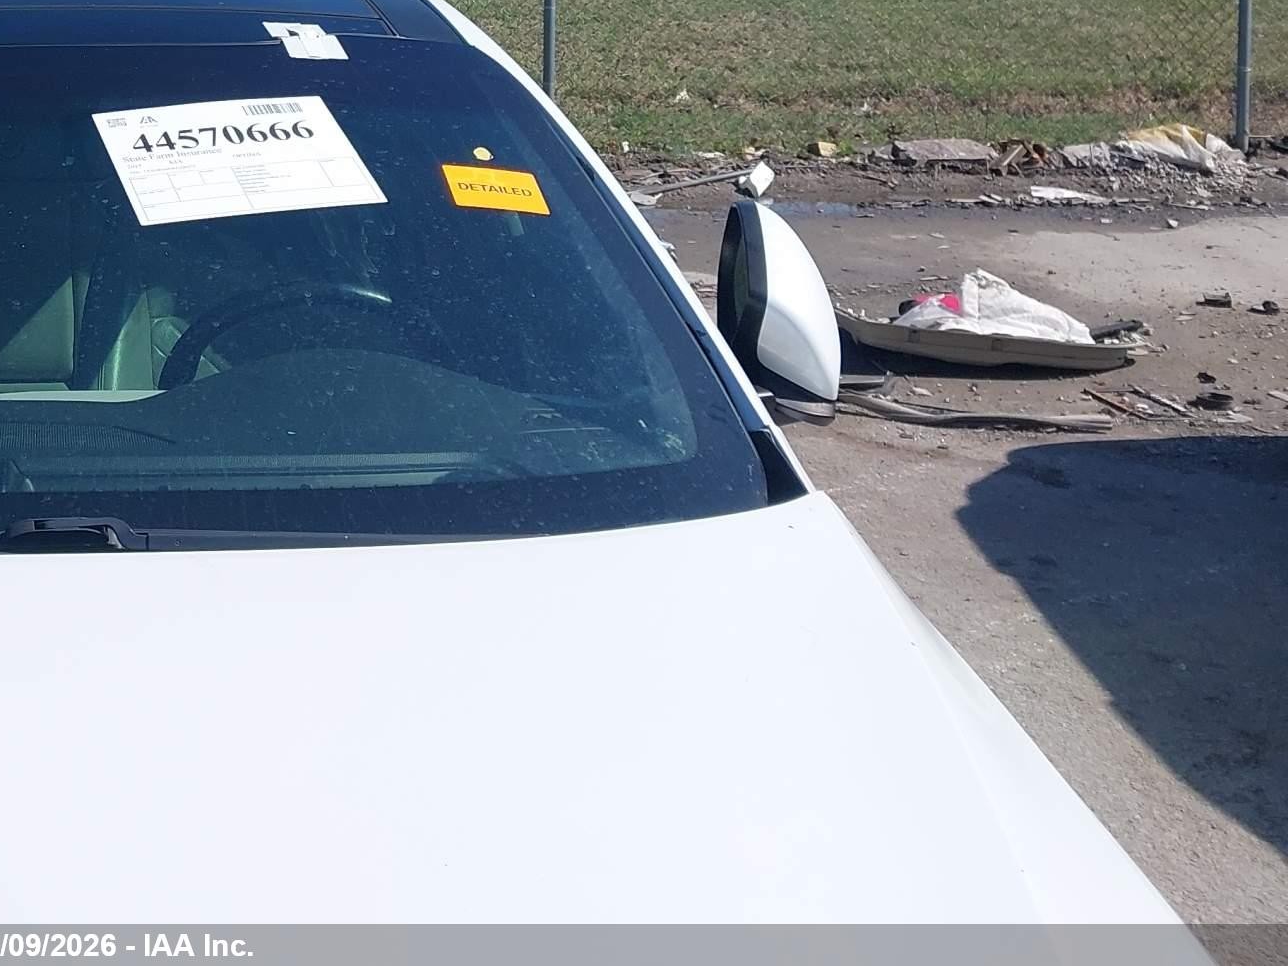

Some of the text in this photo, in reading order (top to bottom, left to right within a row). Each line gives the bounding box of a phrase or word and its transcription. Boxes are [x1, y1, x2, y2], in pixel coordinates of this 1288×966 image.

[133, 119, 315, 153] 44570666
[149, 151, 175, 161] Farm
[457, 182, 533, 197] DETAILED
